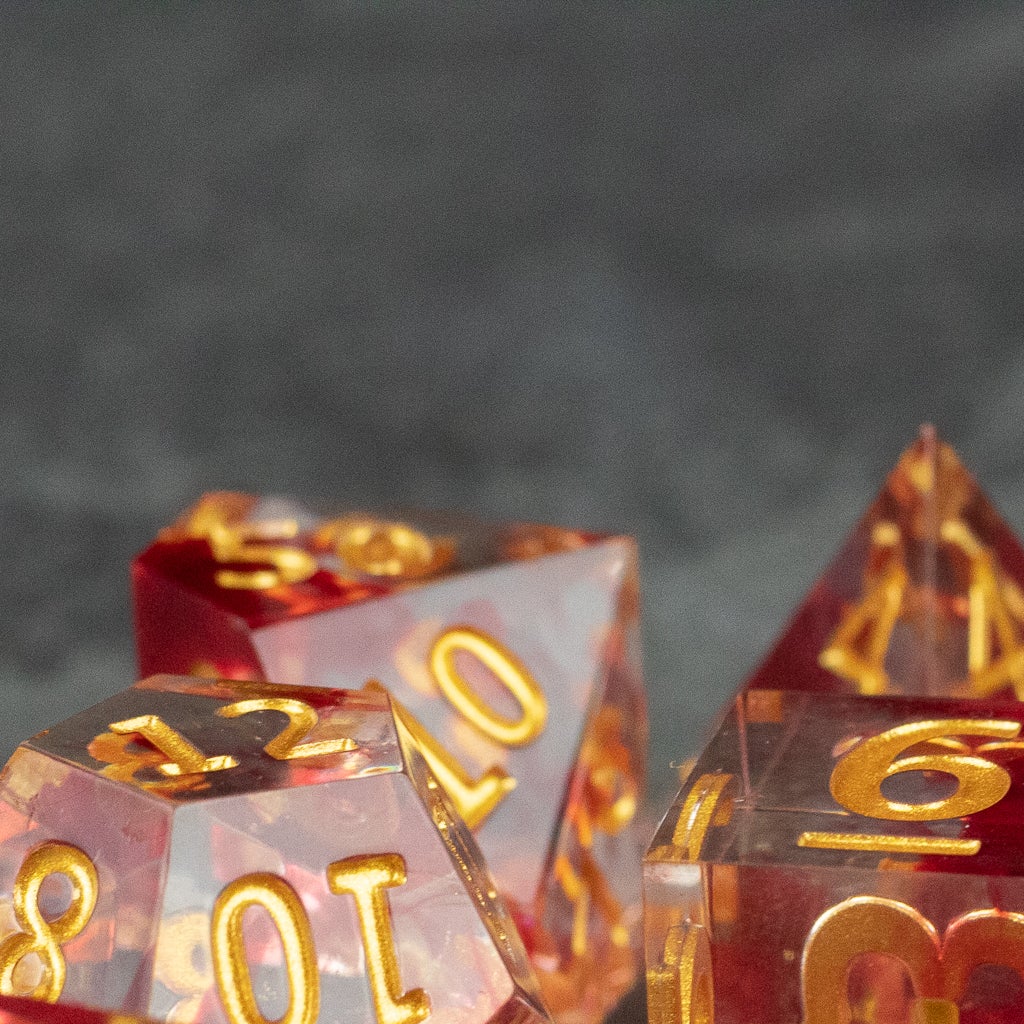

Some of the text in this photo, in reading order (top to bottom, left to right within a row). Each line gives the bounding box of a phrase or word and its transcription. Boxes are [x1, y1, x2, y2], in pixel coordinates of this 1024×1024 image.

[108, 698, 358, 776] 12
[829, 718, 1021, 821] 6
[0, 839, 99, 1004] 8
